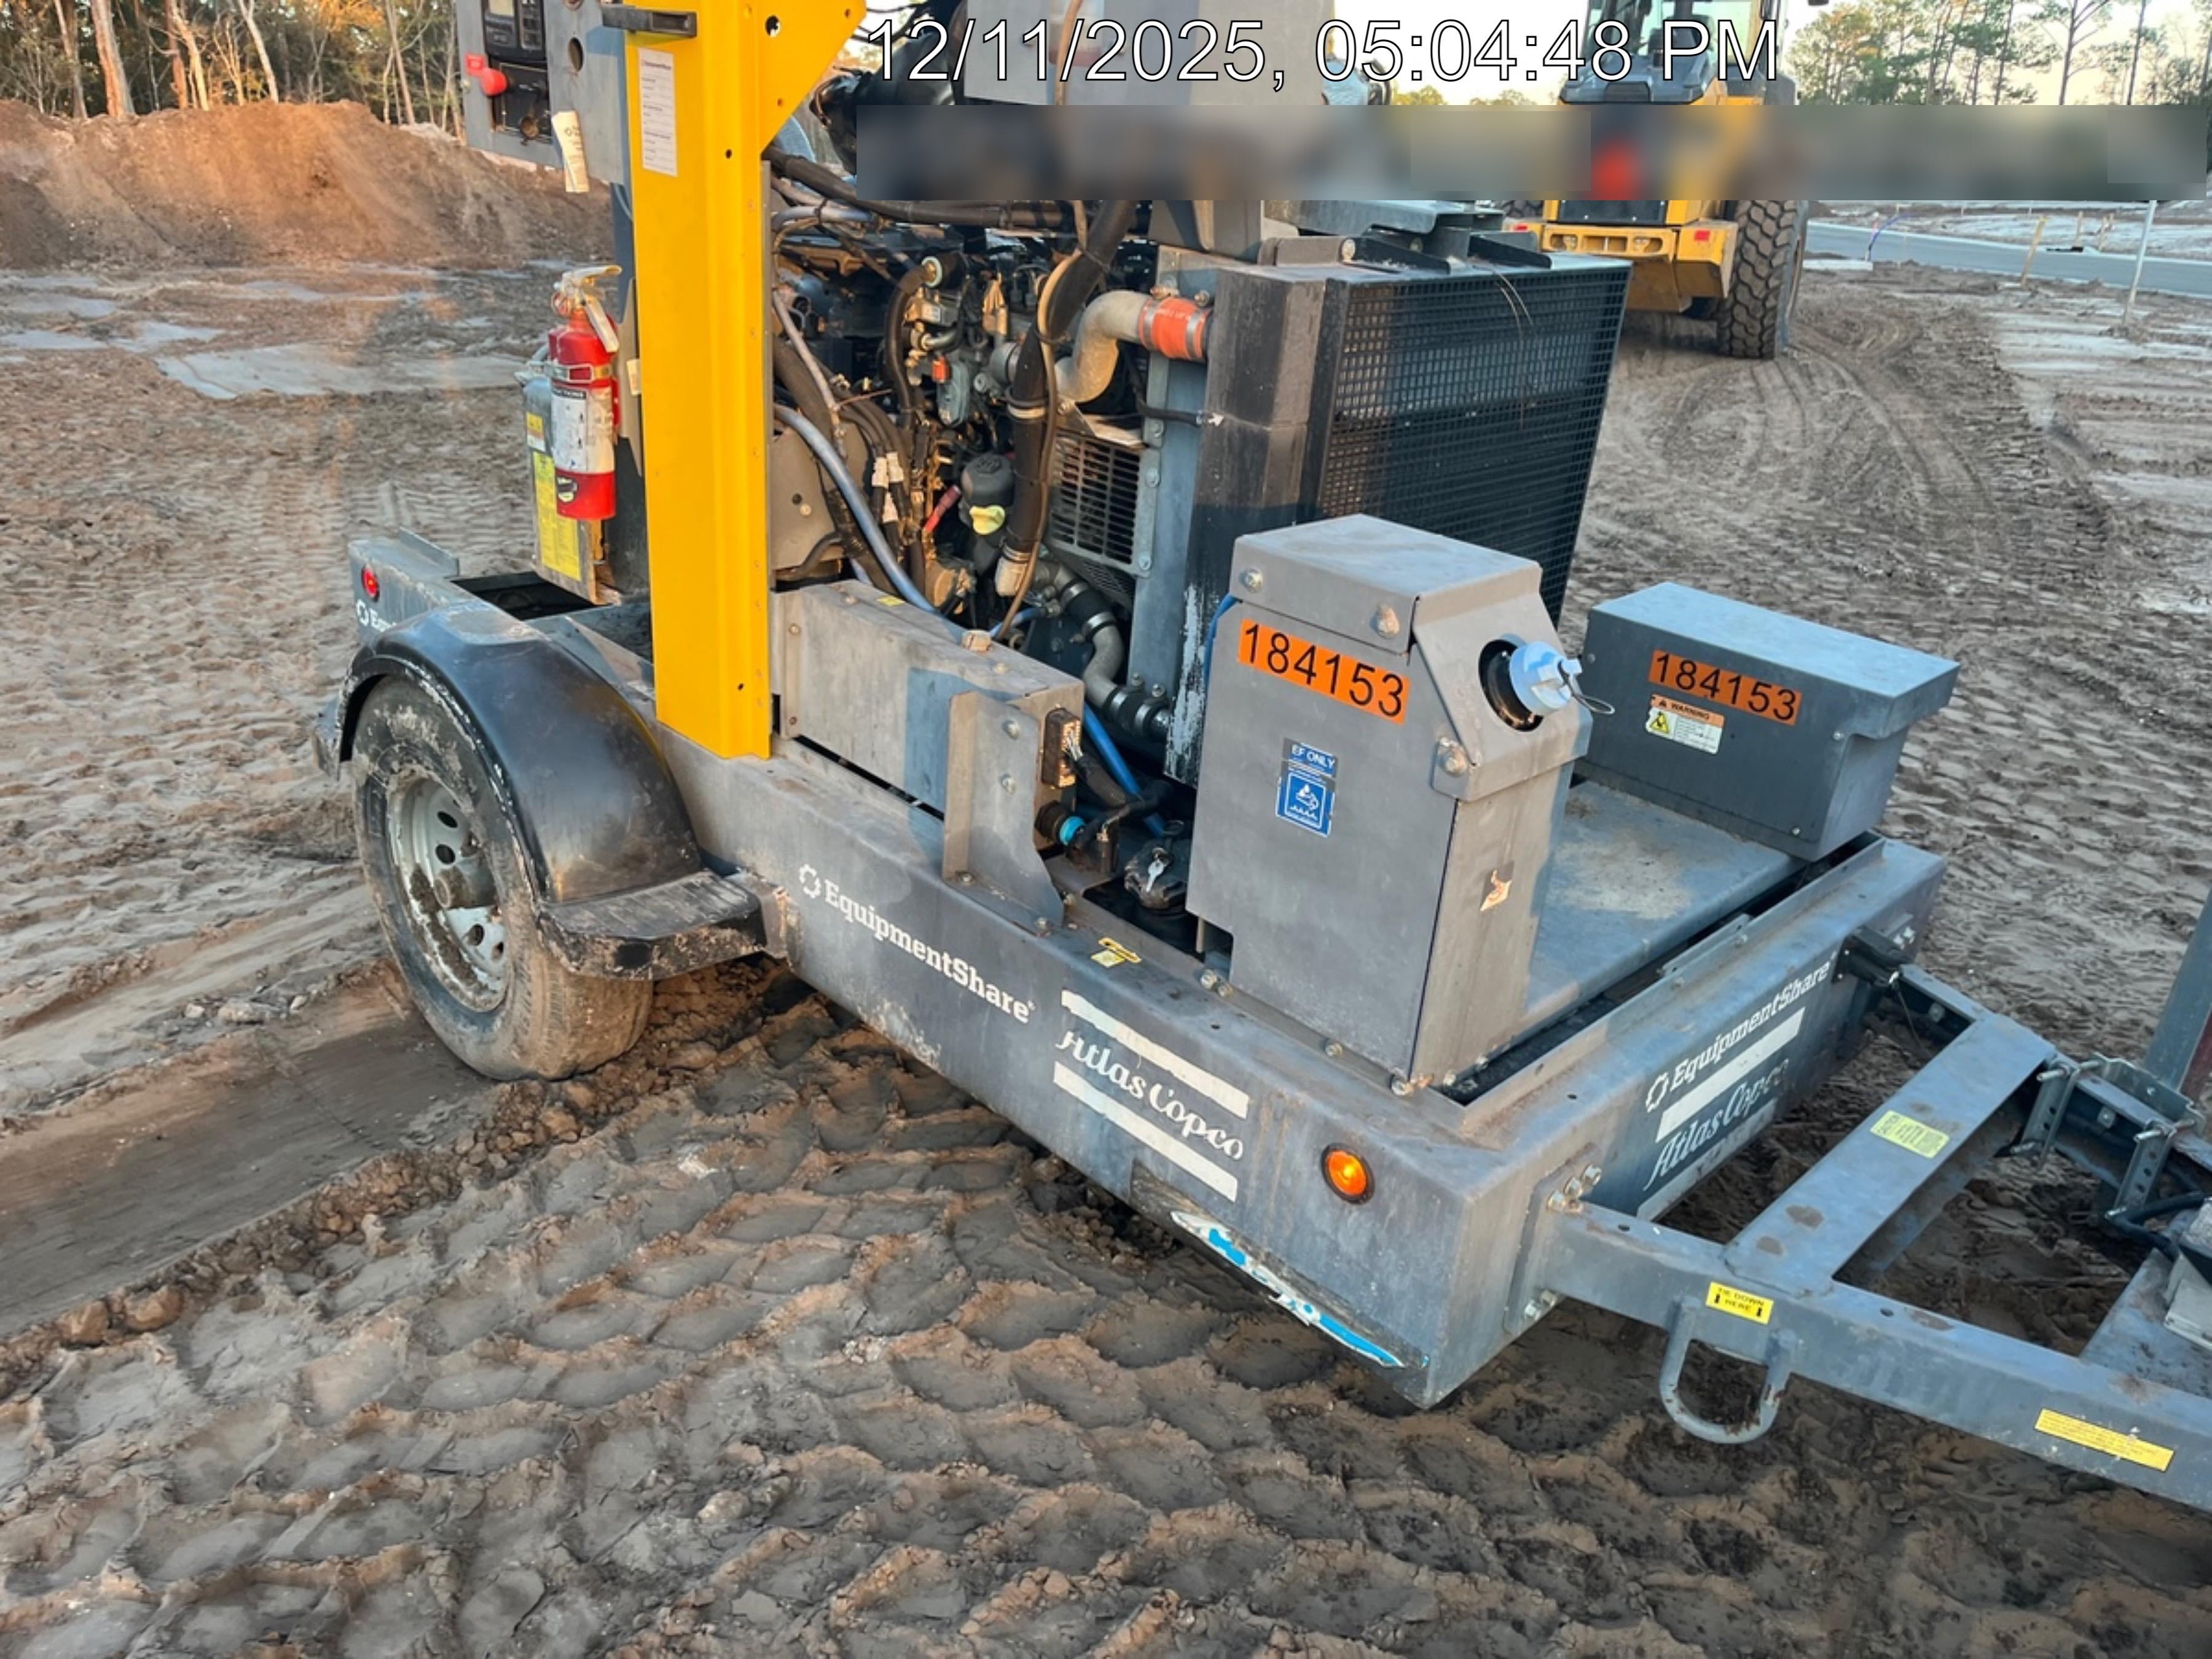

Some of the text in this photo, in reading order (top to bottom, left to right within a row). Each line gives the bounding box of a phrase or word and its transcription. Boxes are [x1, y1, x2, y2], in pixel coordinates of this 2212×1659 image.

[1245, 624, 1404, 718] 184153
[1657, 654, 1796, 721] 184153
[1671, 703, 1709, 720] WARNING
[1306, 751, 1335, 769] ONLY
[1054, 1029, 1244, 1161] Atlas Copco
[1642, 1108, 1723, 1192] Atlas
[1725, 1299, 1751, 1311] HERE
